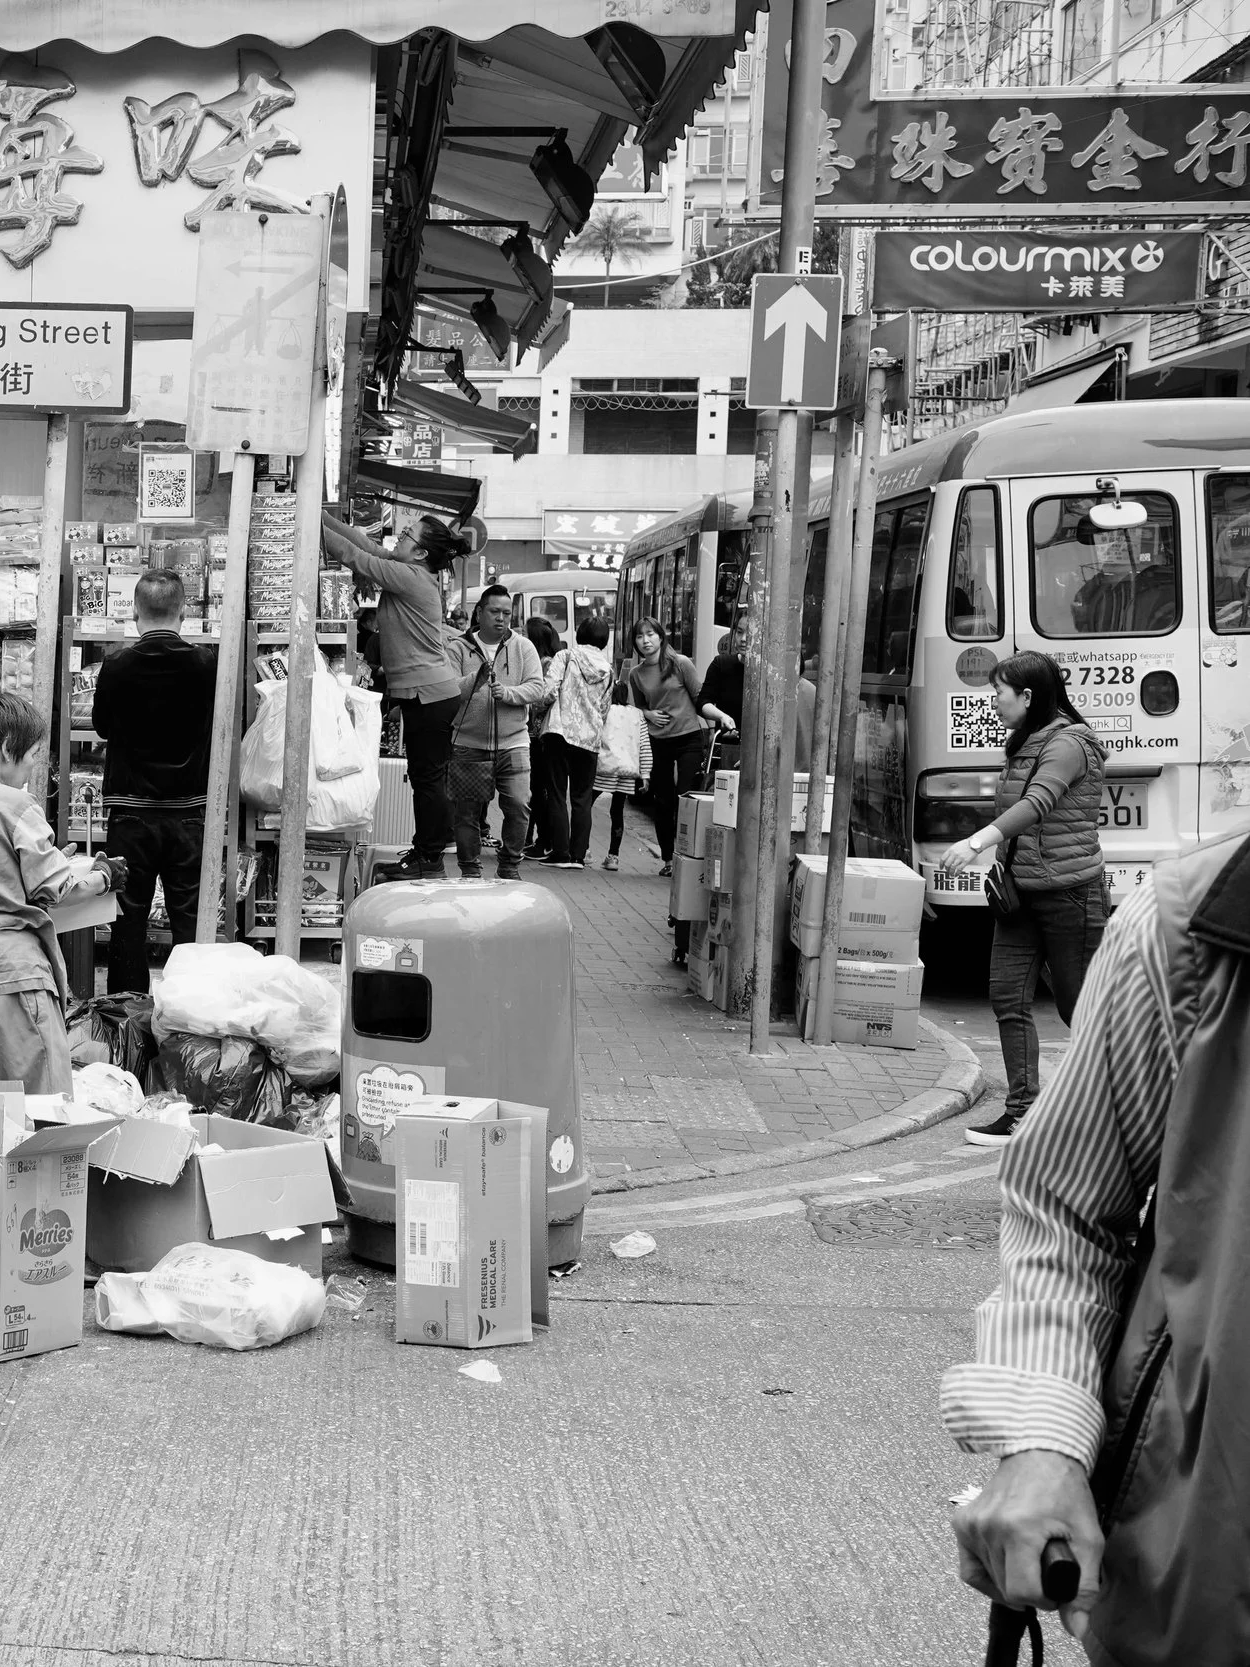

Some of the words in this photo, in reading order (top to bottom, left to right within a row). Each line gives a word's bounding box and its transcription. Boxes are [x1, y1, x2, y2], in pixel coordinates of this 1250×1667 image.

[1041, 276, 1125, 298] 卡萊美
[19, 318, 112, 345] Street
[1079, 666, 1135, 685] 7328
[1092, 692, 1135, 707] 5009
[63, 1154, 84, 1164] 23088
[19, 1222, 73, 1253] Merries
